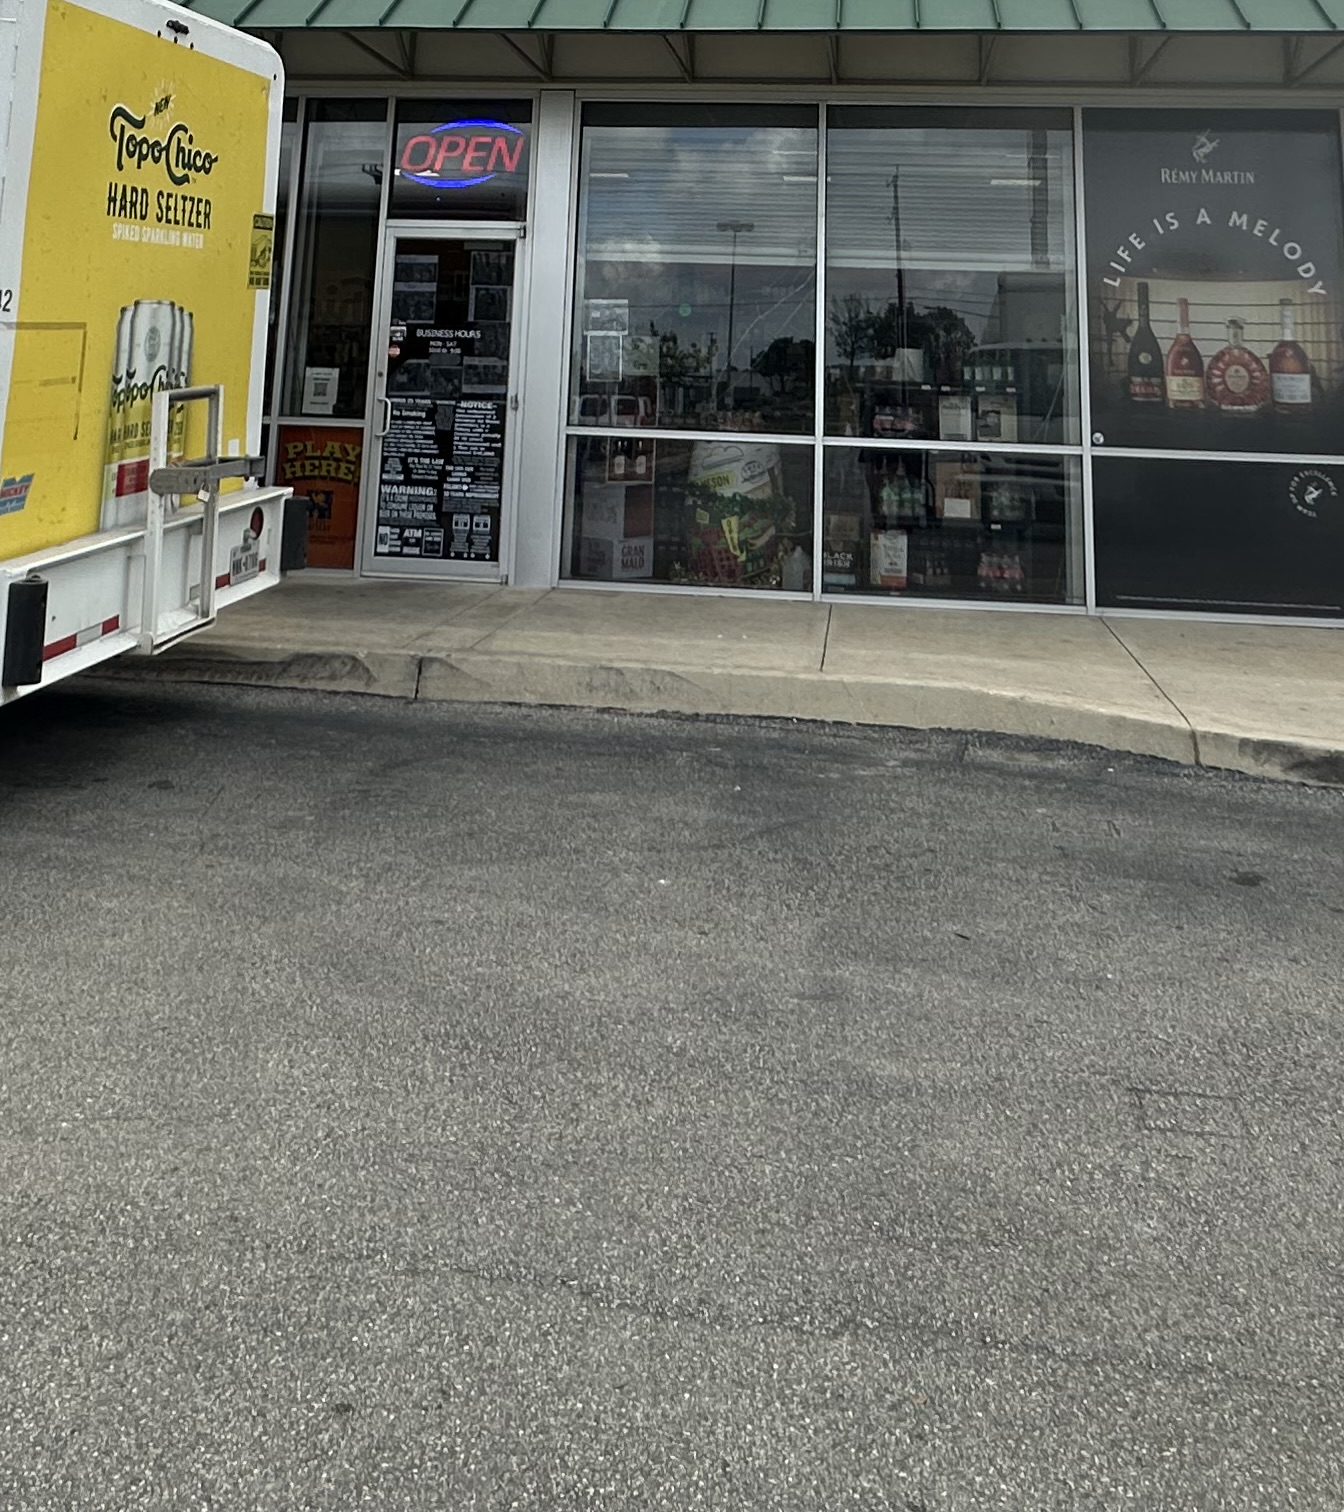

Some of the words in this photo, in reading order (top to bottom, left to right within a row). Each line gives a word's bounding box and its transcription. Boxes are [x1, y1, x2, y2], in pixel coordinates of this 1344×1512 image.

[154, 94, 173, 116] NEW
[400, 135, 525, 173] OPEN
[1161, 168, 1198, 184] RÉMY
[1201, 168, 1255, 185] MARTIN
[107, 182, 149, 221] HARD
[155, 190, 212, 230] SELTZER
[112, 223, 140, 242] SPIKED
[1103, 233, 1146, 287] LIFE
[1153, 212, 1179, 235] IS
[1196, 207, 1212, 226] A
[1228, 210, 1327, 296] MELODY
[416, 329, 454, 339] BUSINESS
[454, 329, 482, 339] HOURS
[460, 400, 494, 410] NOTICE
[285, 441, 362, 463] PLAY
